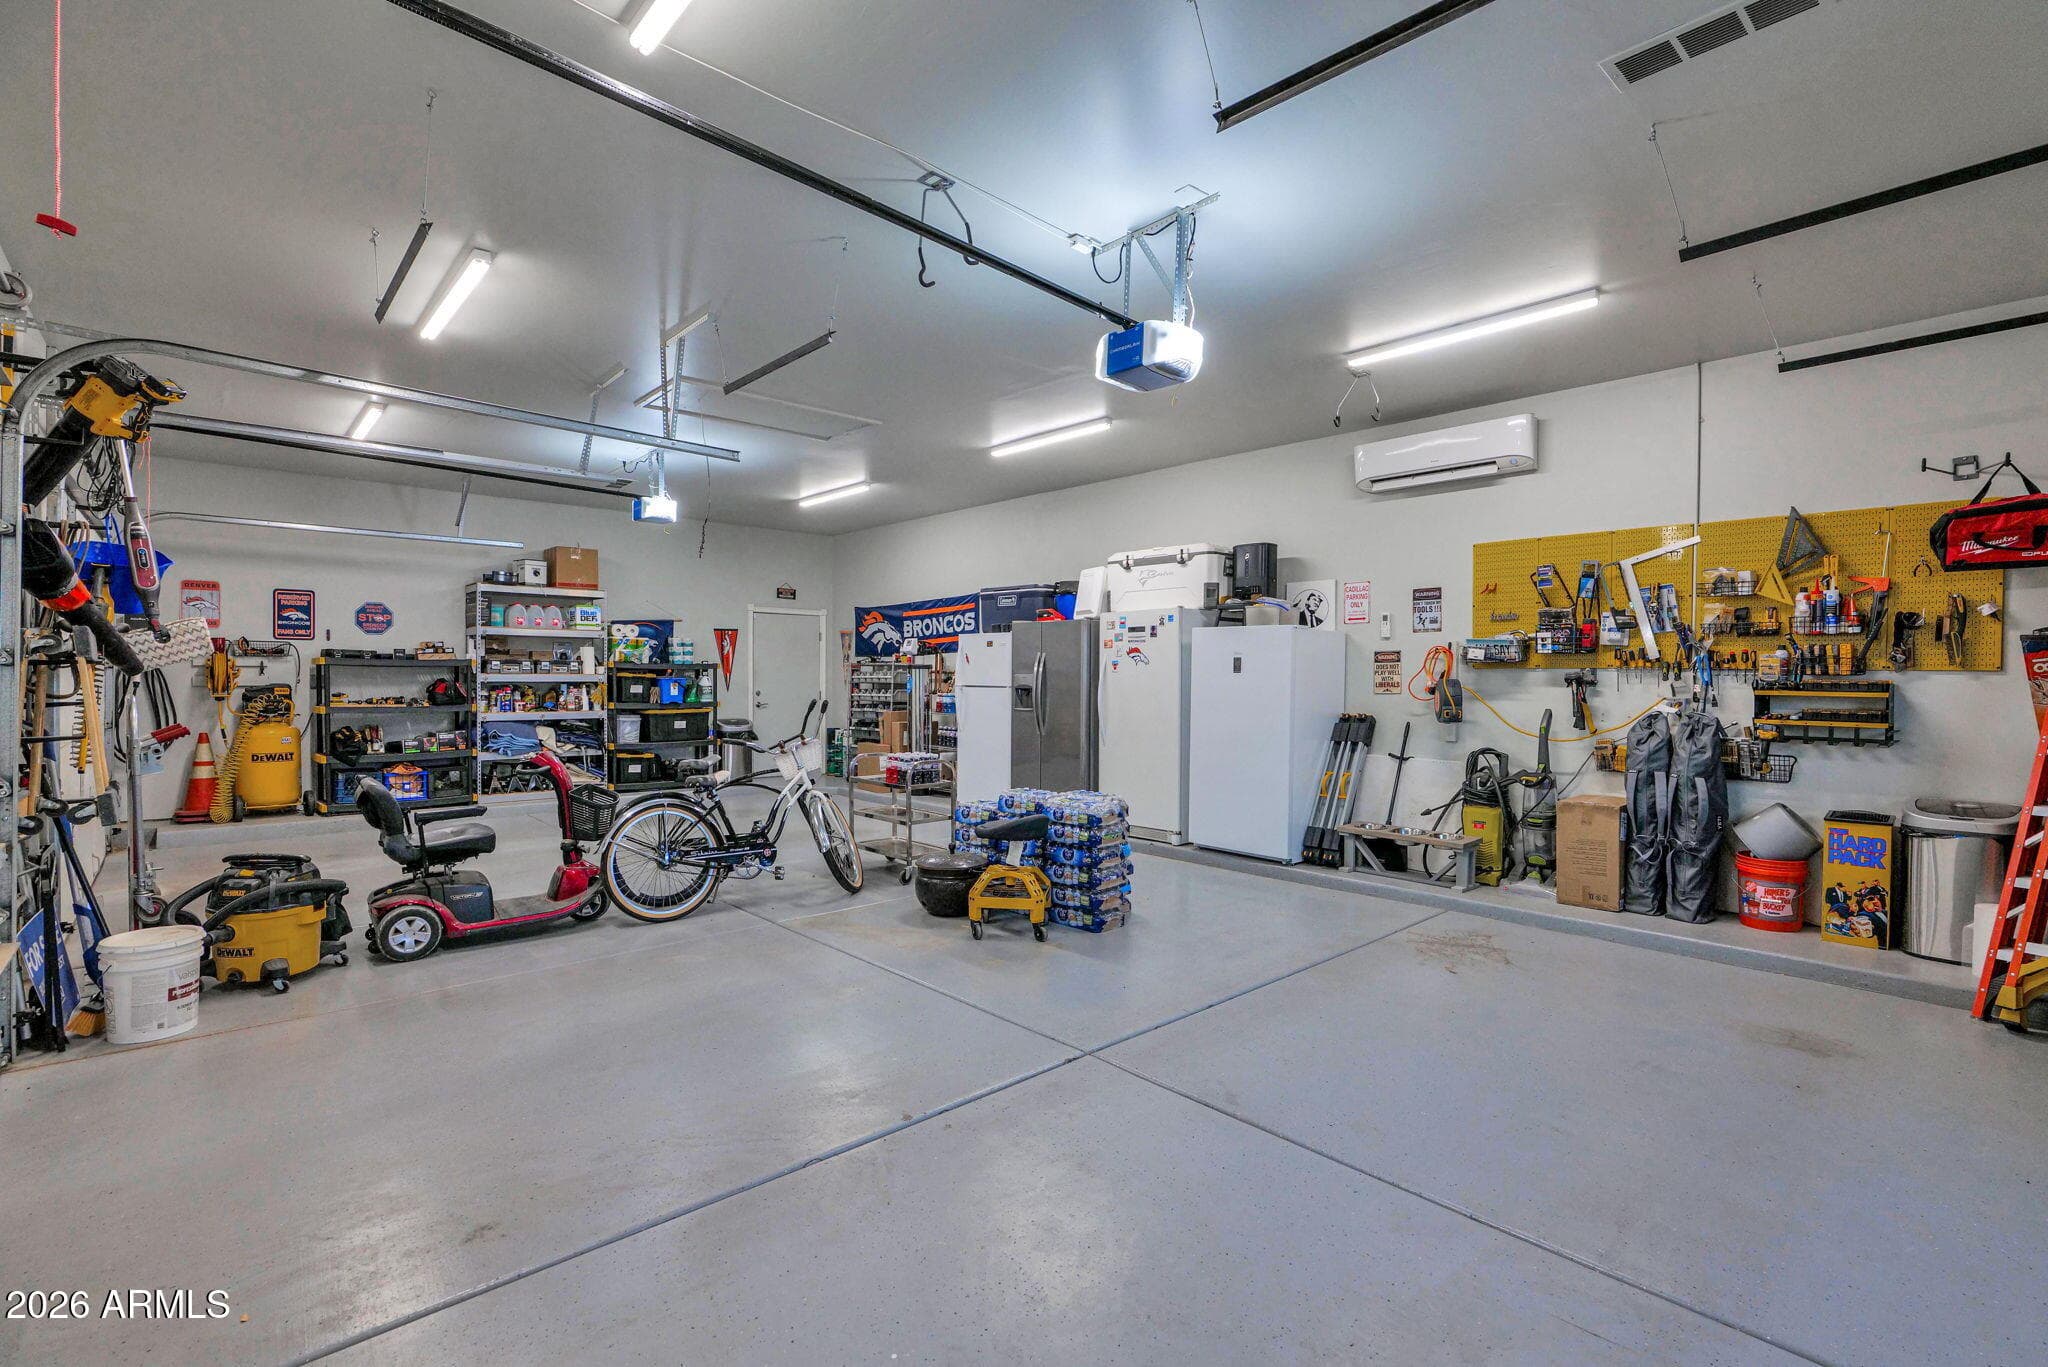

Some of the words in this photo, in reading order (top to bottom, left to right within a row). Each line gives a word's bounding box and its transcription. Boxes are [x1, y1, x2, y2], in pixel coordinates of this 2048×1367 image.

[1960, 536, 2019, 552] Miaukee
[358, 613, 392, 621] STOP
[1413, 605, 1433, 613] TOOLS
[903, 612, 976, 637] BRONCOS
[1829, 834, 1887, 853] HARD
[1828, 849, 1887, 869] PACK
[1762, 902, 1786, 911] BUCKET
[24, 942, 44, 978] FOR
